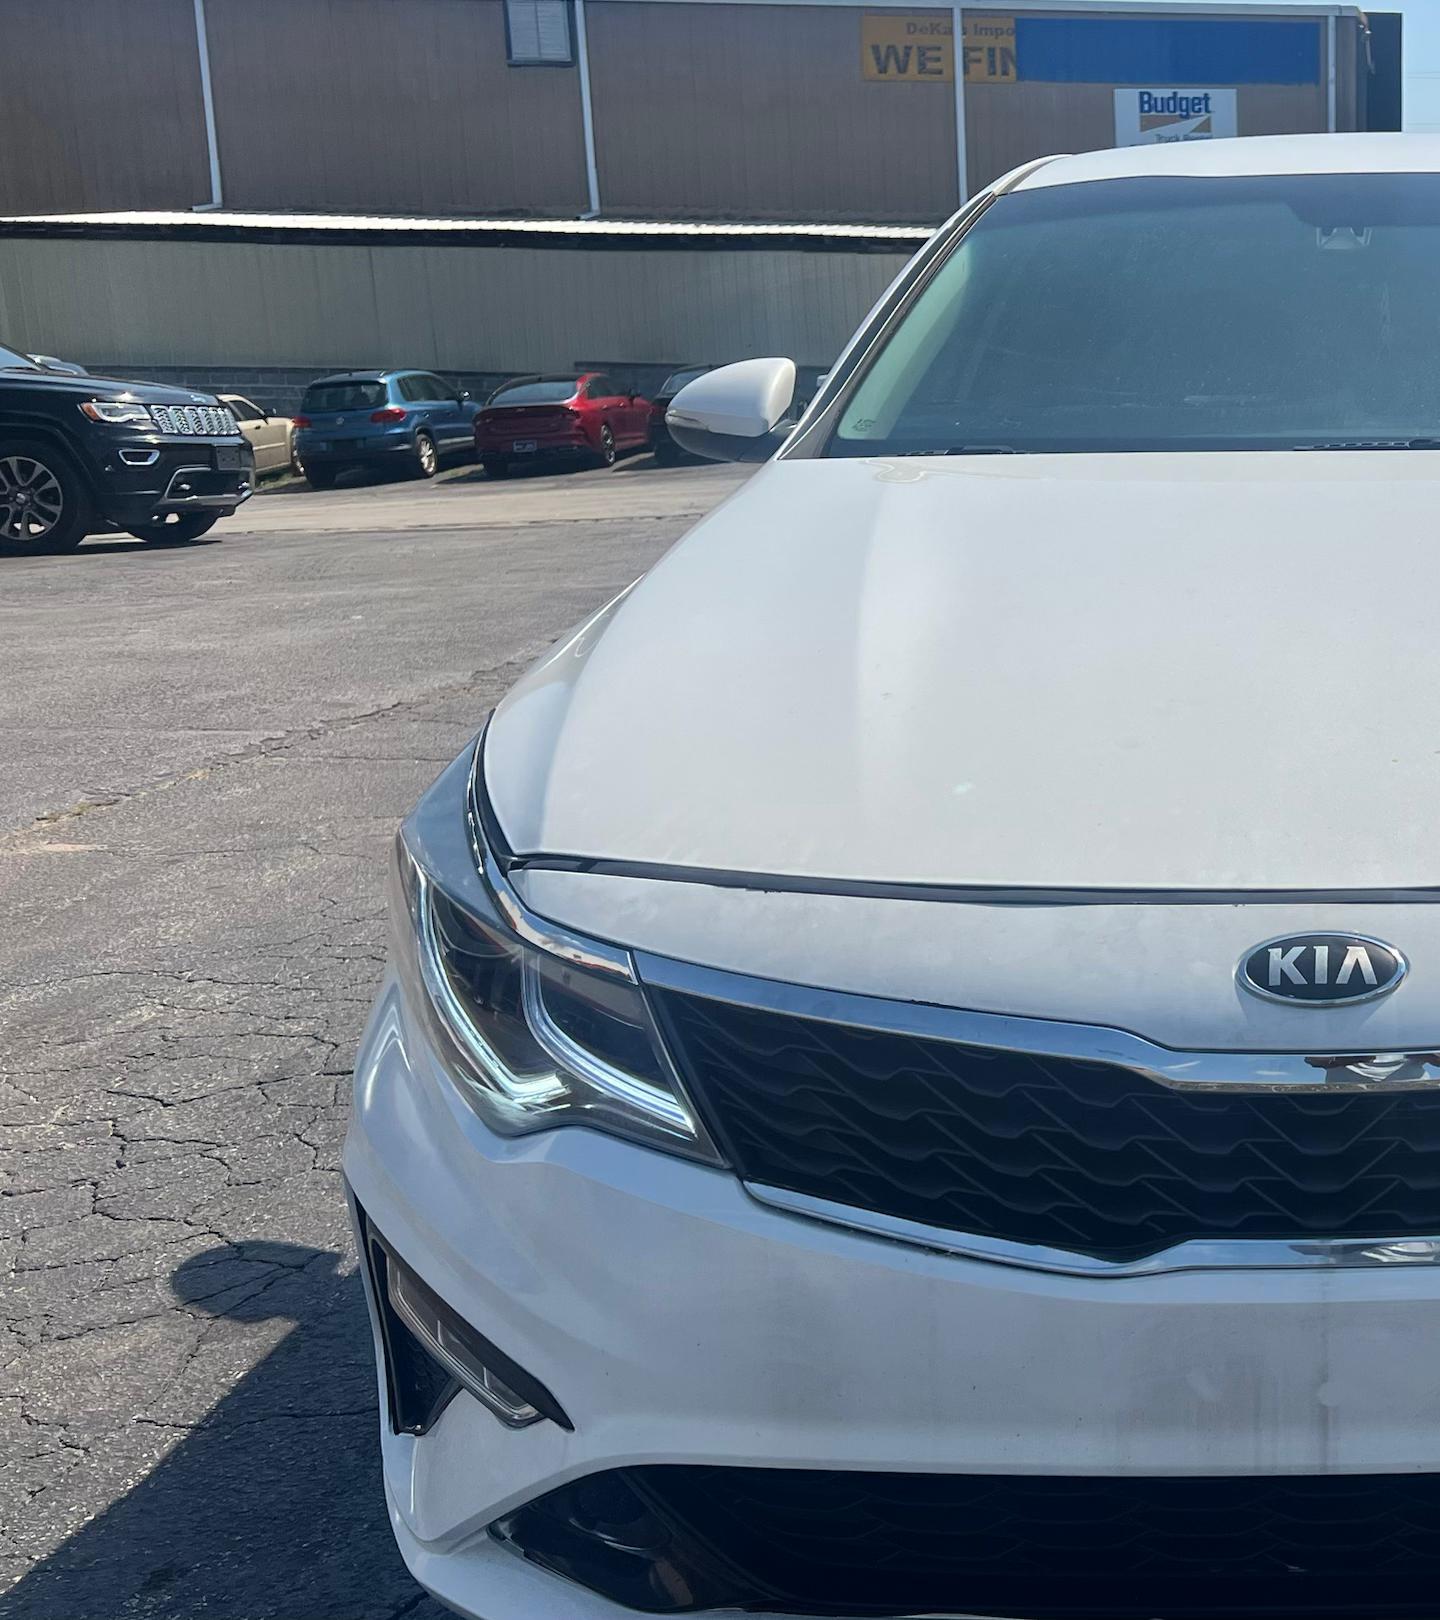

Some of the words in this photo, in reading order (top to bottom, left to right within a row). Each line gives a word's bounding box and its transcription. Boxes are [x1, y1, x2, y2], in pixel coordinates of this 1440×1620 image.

[870, 44, 943, 75] WE
[1139, 91, 1212, 120] Budget
[1268, 945, 1378, 986] KIA
